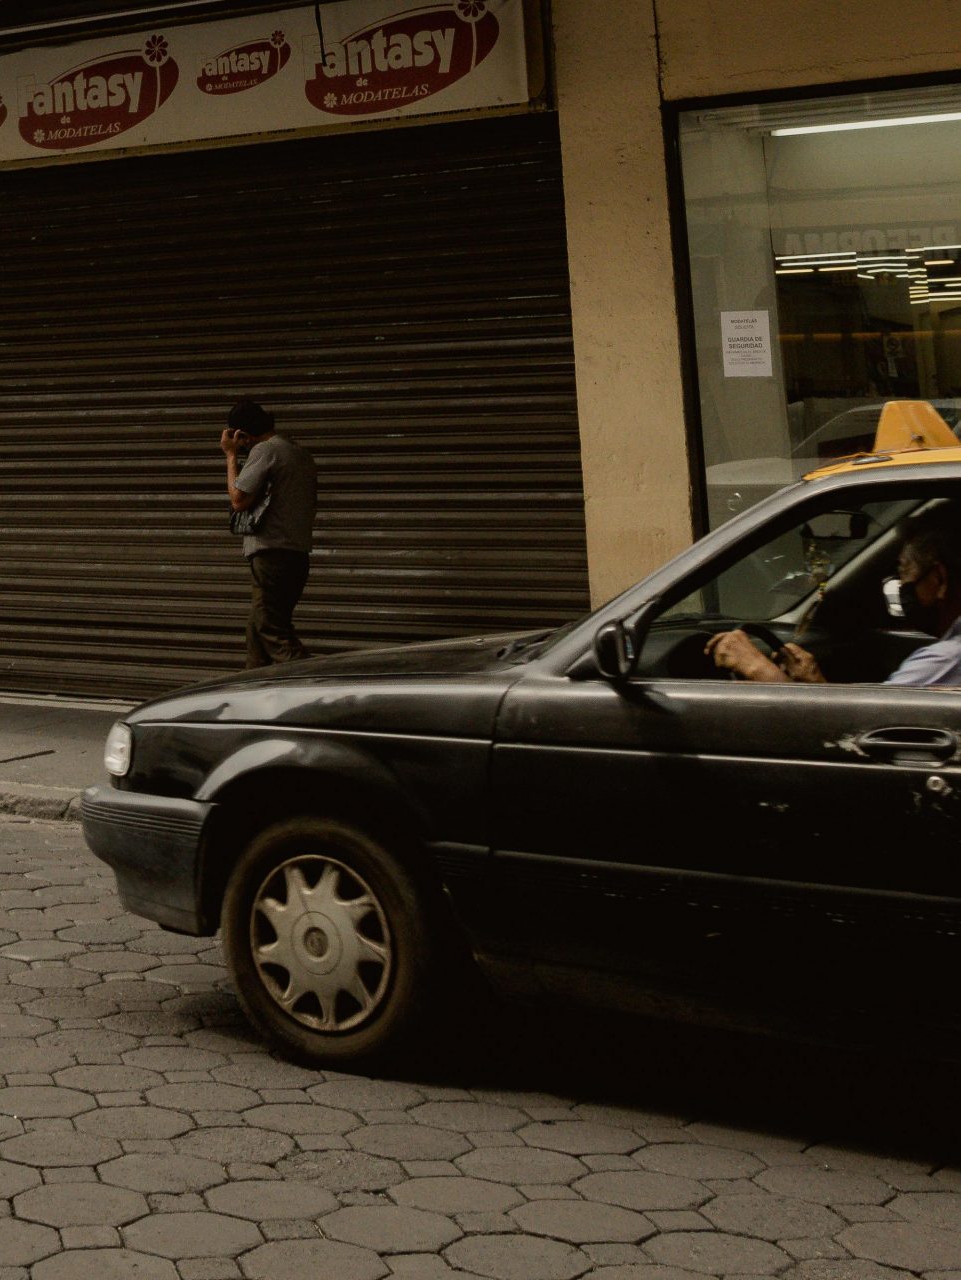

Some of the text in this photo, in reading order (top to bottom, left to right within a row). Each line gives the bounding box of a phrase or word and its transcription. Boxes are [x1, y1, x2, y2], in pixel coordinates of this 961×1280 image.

[355, 77, 368, 88] de
[340, 83, 430, 106] MODATELAS
[60, 115, 71, 124] de
[47, 122, 121, 141] MODATELAS
